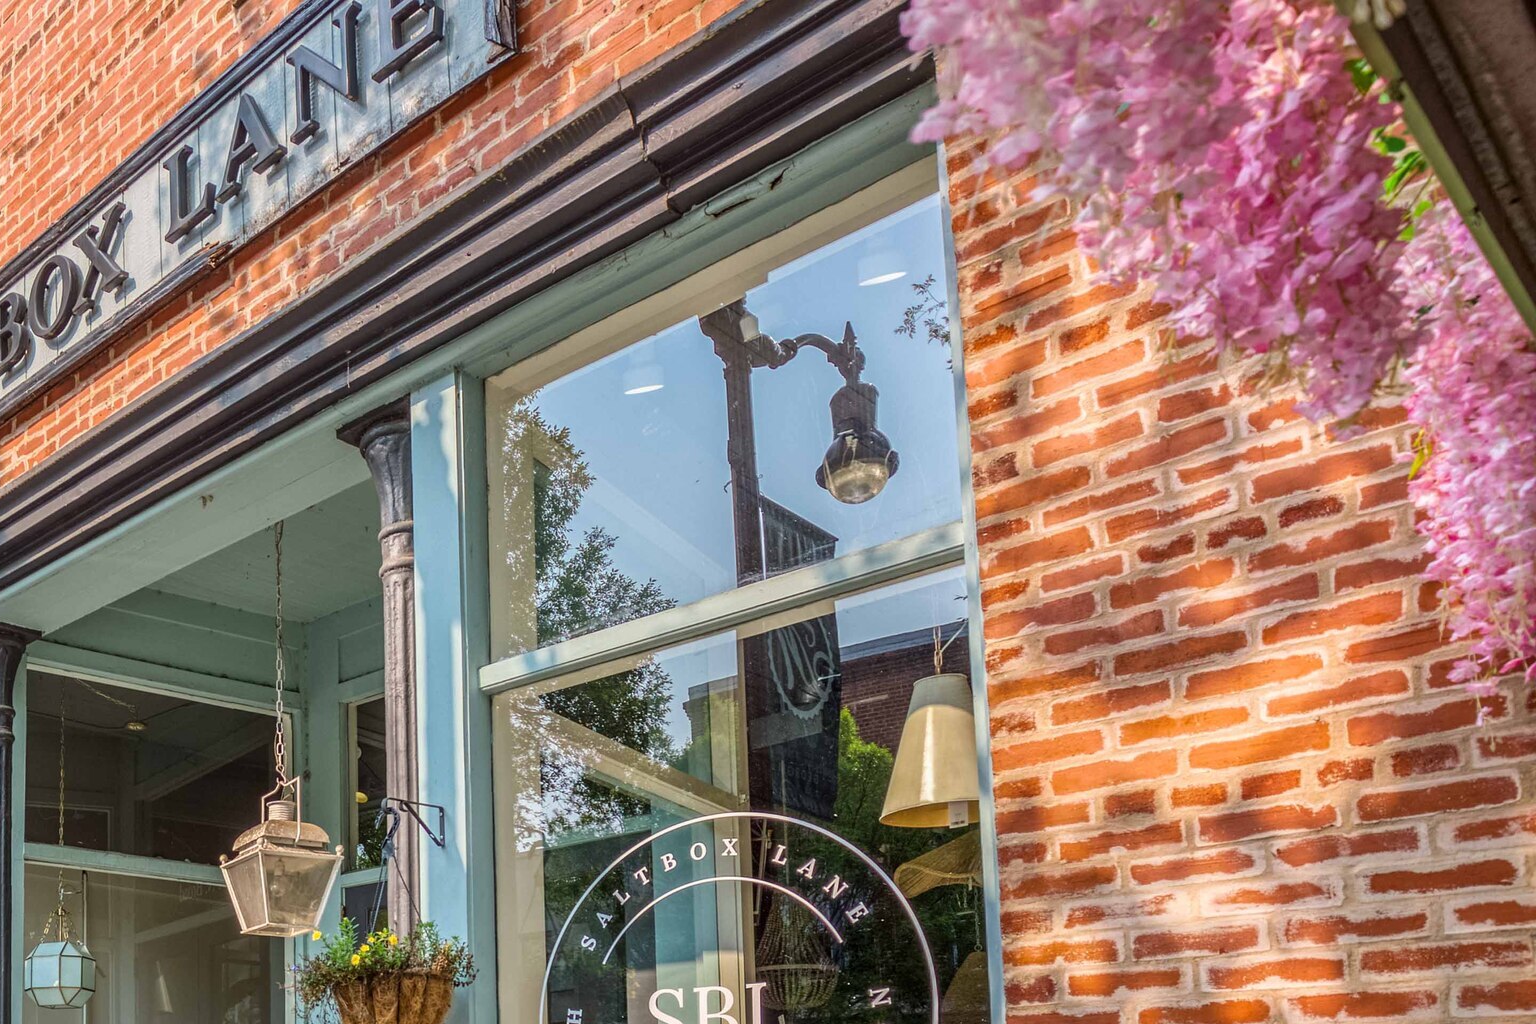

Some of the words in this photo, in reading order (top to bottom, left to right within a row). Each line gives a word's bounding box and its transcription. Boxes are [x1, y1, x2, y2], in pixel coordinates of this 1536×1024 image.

[163, 0, 445, 244] LANE
[580, 837, 739, 952] SALTBOX
[772, 844, 869, 925] LANE
